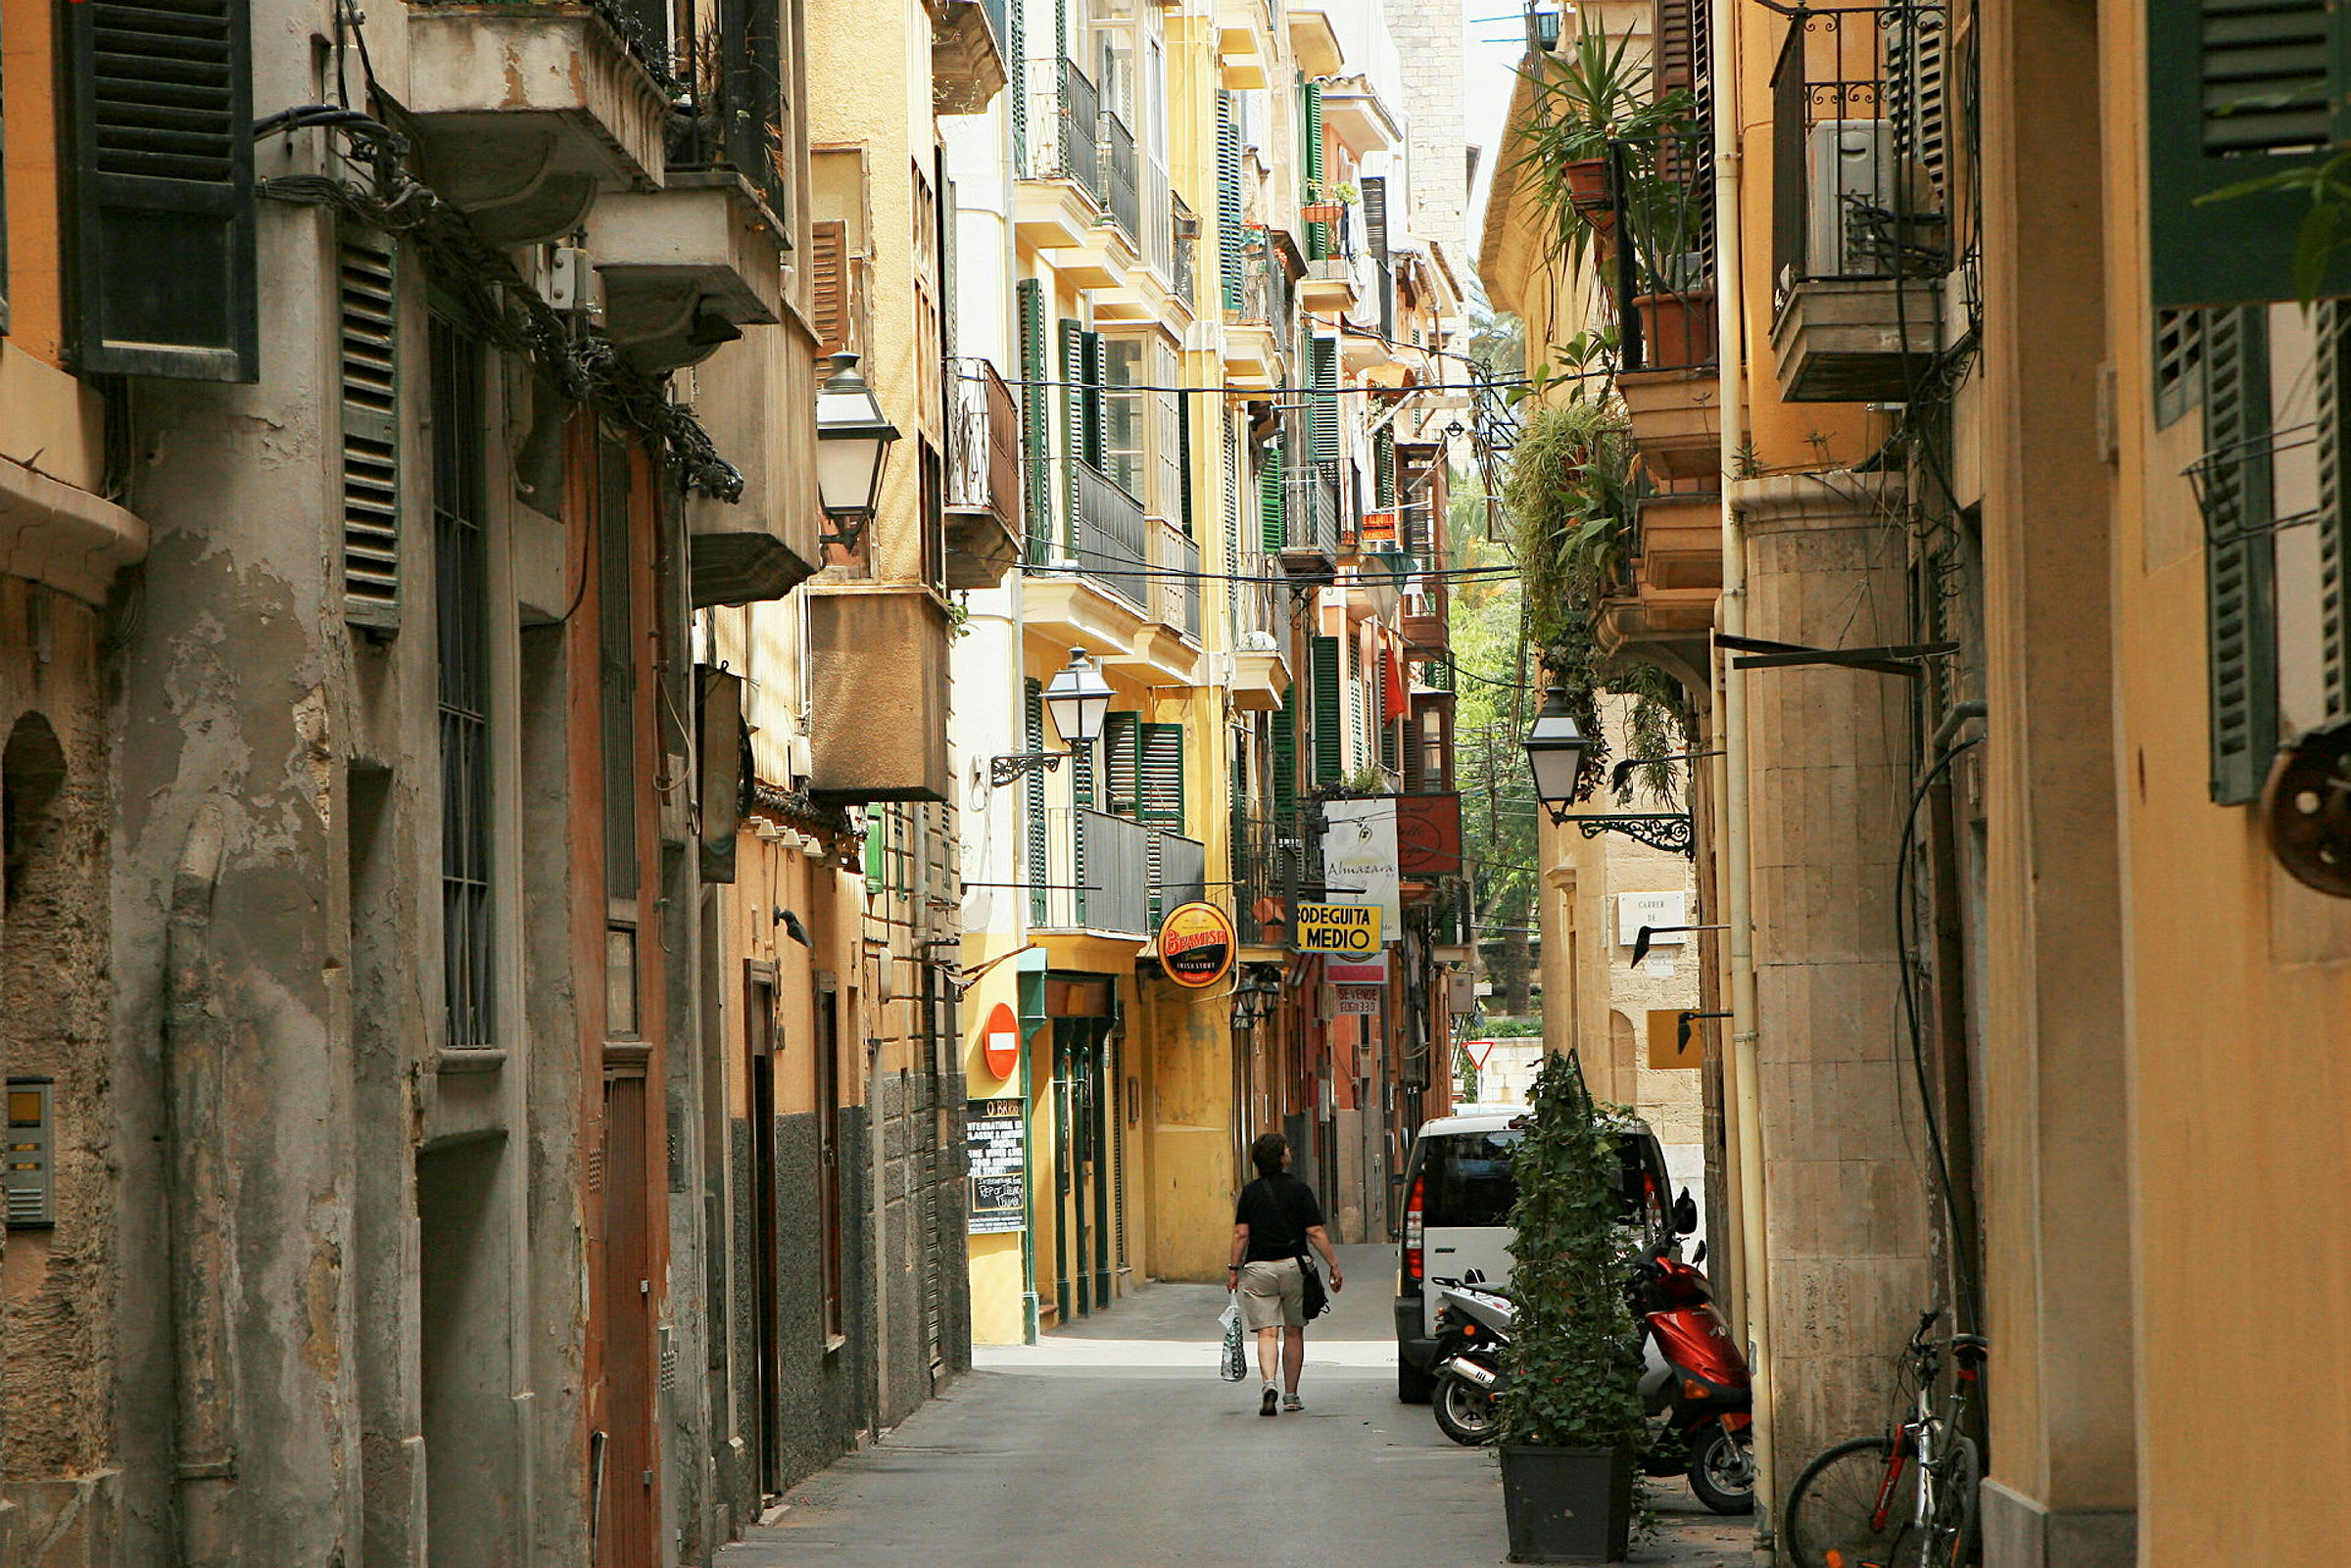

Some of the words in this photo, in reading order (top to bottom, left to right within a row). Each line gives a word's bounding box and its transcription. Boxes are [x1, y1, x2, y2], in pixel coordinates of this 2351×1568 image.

[1326, 862, 1394, 877] Almazara
[1165, 928, 1228, 957] BEAMISH
[1306, 927, 1370, 950] MEDIO
[1350, 988, 1378, 1001] VENDE
